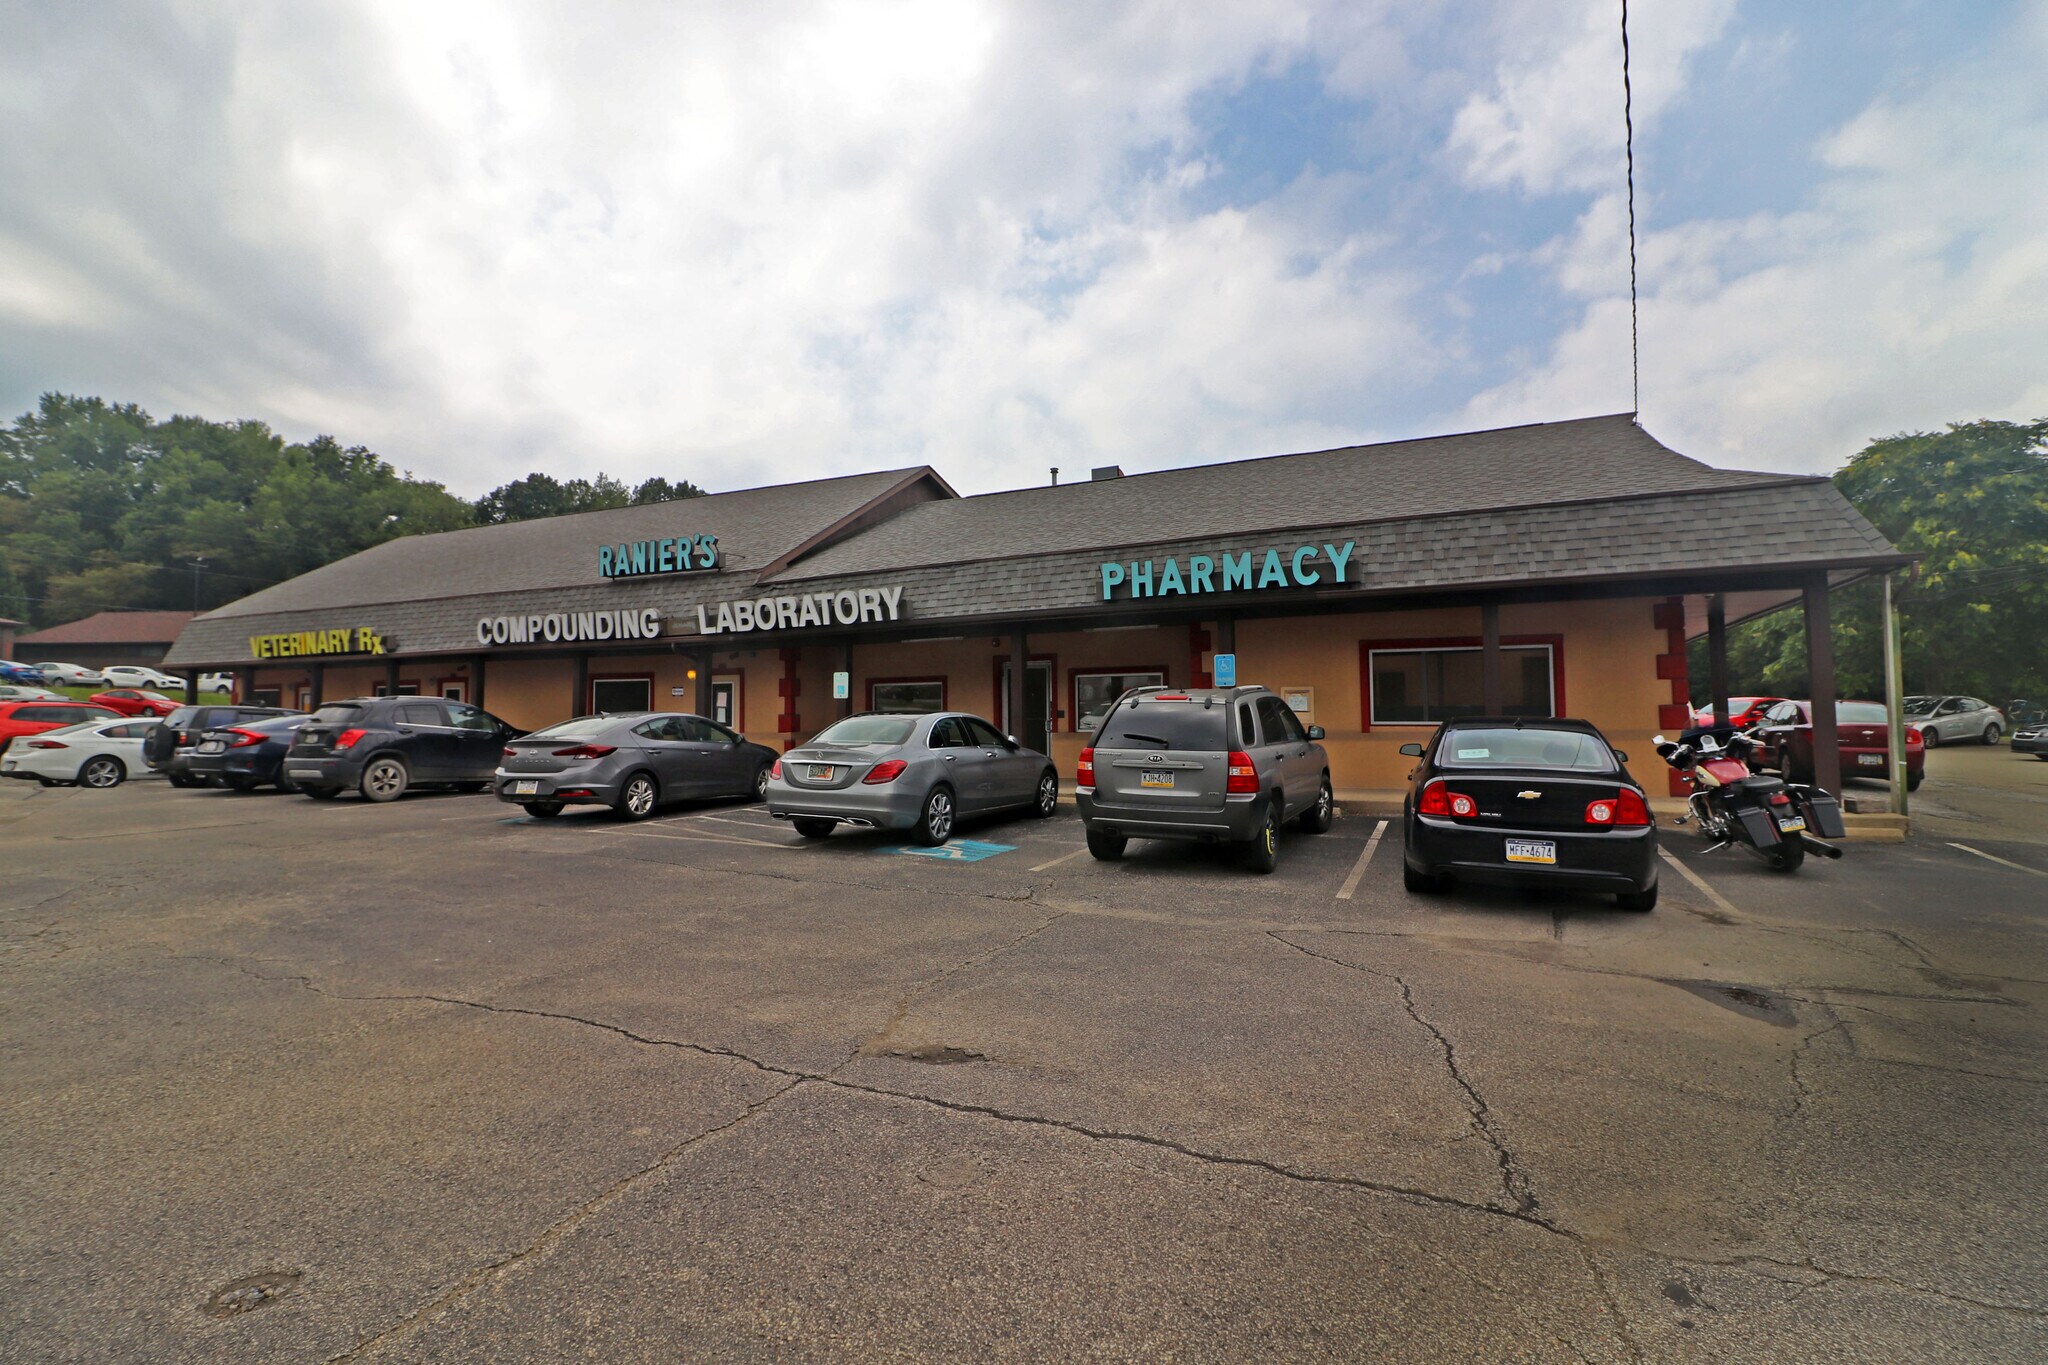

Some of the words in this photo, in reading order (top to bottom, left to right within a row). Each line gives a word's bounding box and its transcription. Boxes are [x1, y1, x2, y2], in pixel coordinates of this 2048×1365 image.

[598, 532, 718, 577] RANIER'S
[1101, 541, 1357, 600] PHARMACY
[477, 607, 661, 645] COMPOUNDING
[697, 585, 904, 635] LABORATORY
[249, 628, 352, 658] VETERINARY
